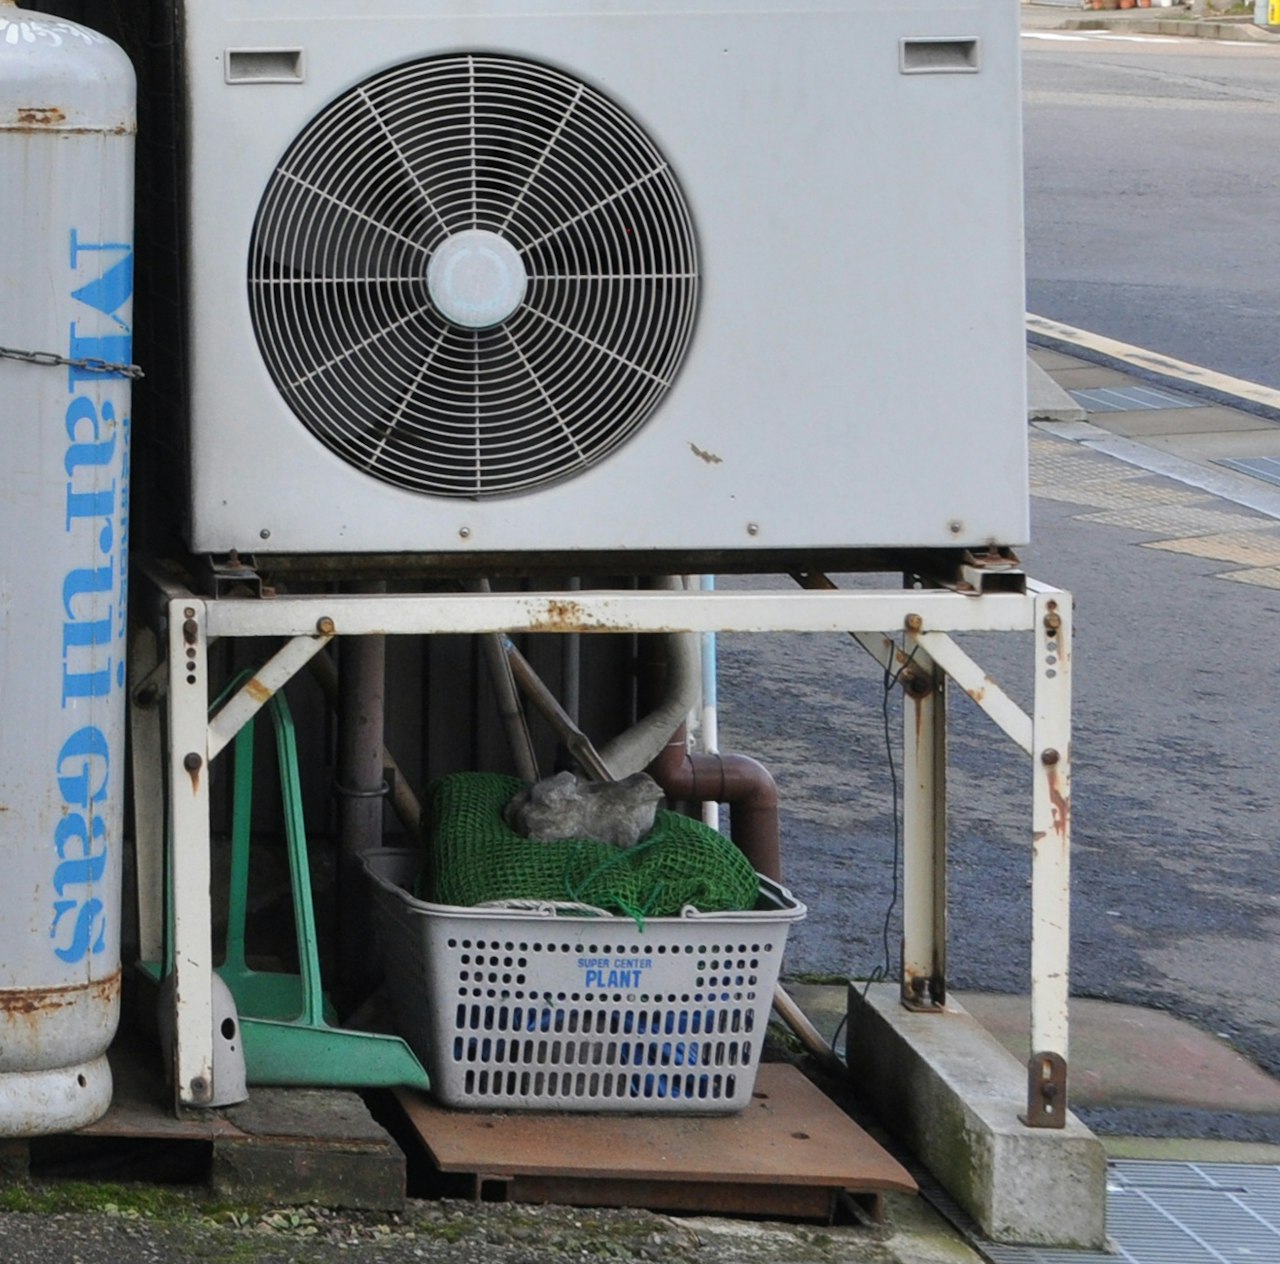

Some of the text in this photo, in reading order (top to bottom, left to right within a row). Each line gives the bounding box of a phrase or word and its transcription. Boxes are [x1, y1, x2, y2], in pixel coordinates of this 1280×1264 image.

[62, 229, 134, 708] Marui
[577, 958, 652, 969] SUPER CENTER
[585, 970, 642, 988] PLANT
